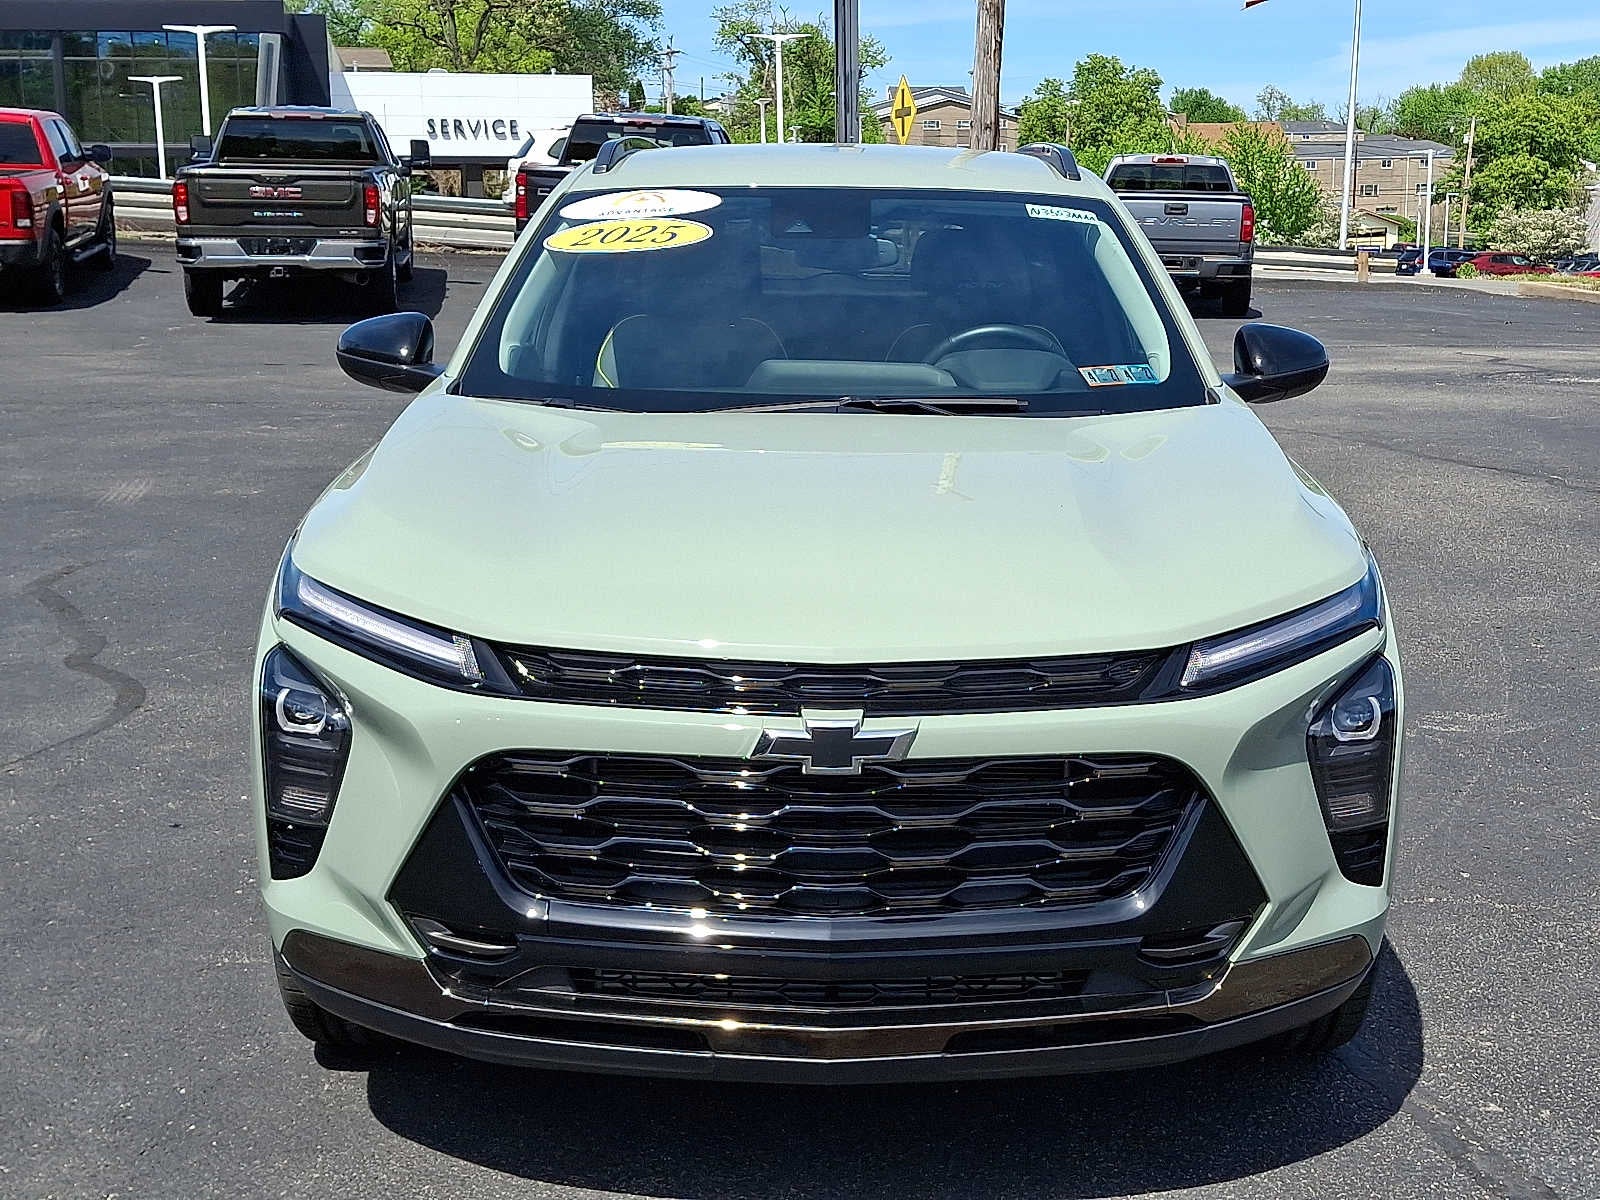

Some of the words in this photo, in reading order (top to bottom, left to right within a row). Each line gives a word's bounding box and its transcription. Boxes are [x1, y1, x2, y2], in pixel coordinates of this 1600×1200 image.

[427, 118, 519, 138] SERVICE
[249, 186, 302, 198] GMC
[570, 225, 686, 247] 2025
